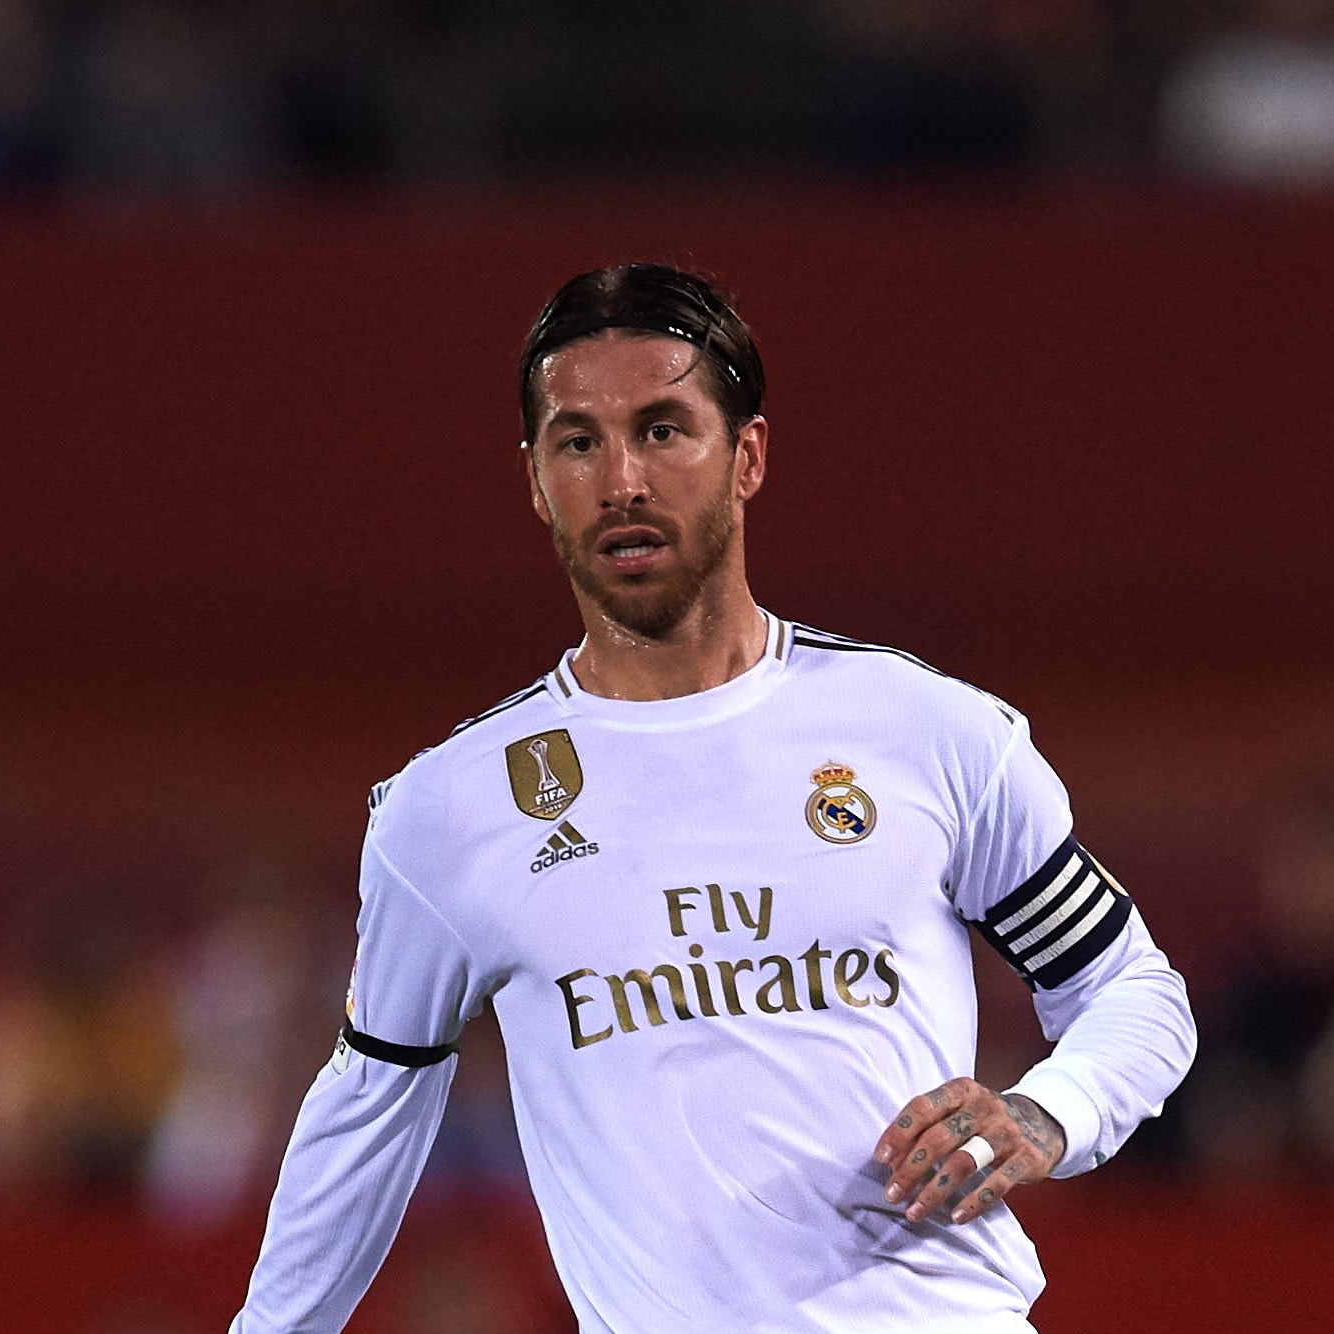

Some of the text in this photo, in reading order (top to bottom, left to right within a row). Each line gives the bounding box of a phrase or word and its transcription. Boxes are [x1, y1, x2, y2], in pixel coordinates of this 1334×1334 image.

[535, 787, 567, 805] FIFA
[530, 842, 599, 873] adidas
[662, 883, 773, 941] Fly
[554, 938, 900, 1049] Emirates
